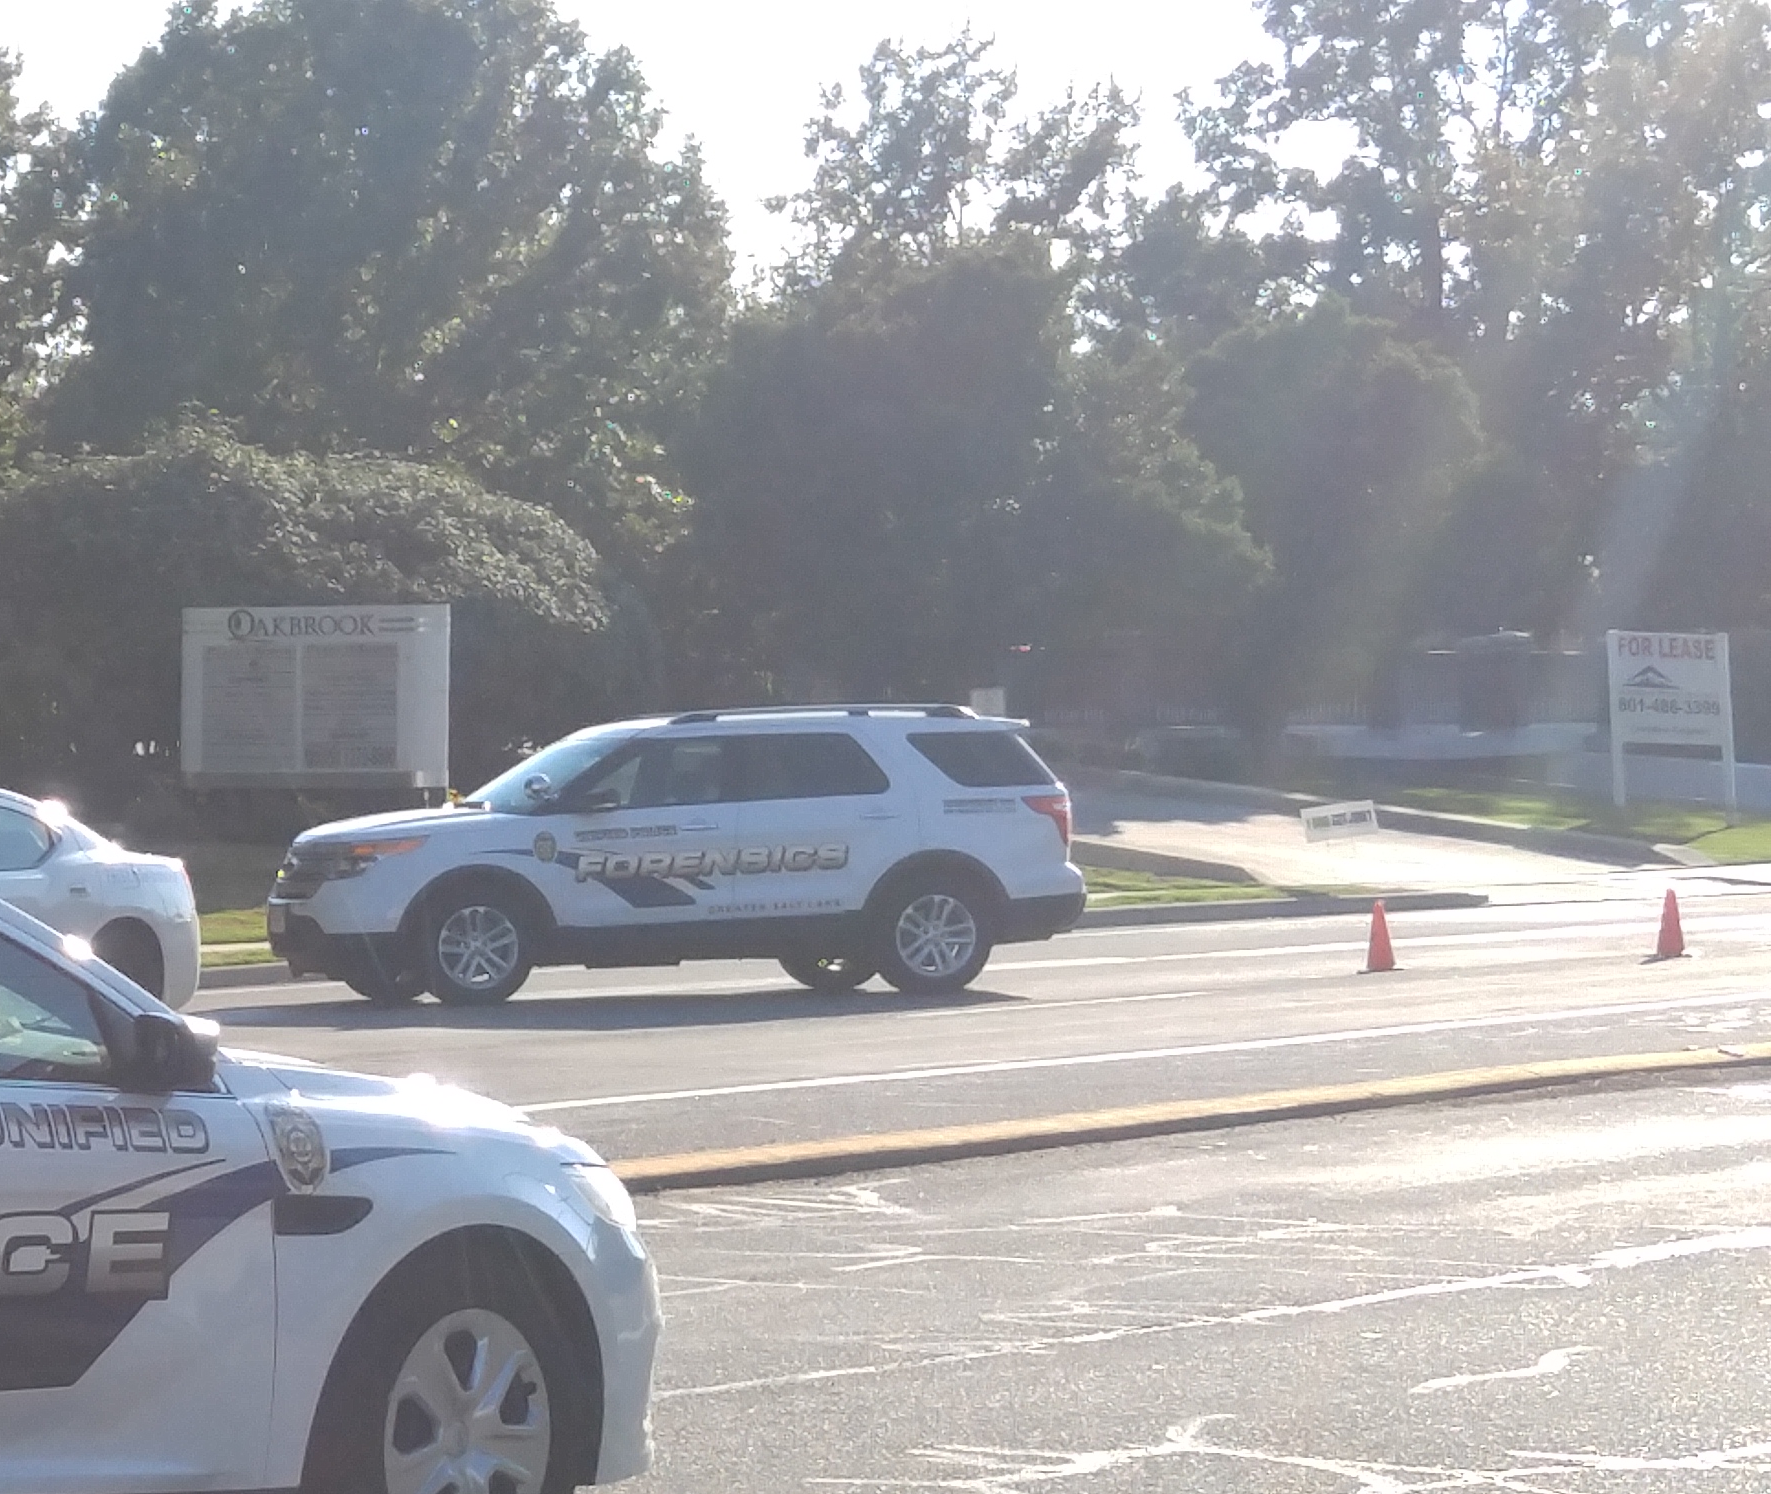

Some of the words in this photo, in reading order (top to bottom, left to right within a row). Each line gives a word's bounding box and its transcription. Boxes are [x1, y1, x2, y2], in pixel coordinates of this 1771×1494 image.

[1617, 636, 1654, 659] FOR
[1658, 637, 1716, 661] LEASE
[574, 842, 849, 882] FORENSICS
